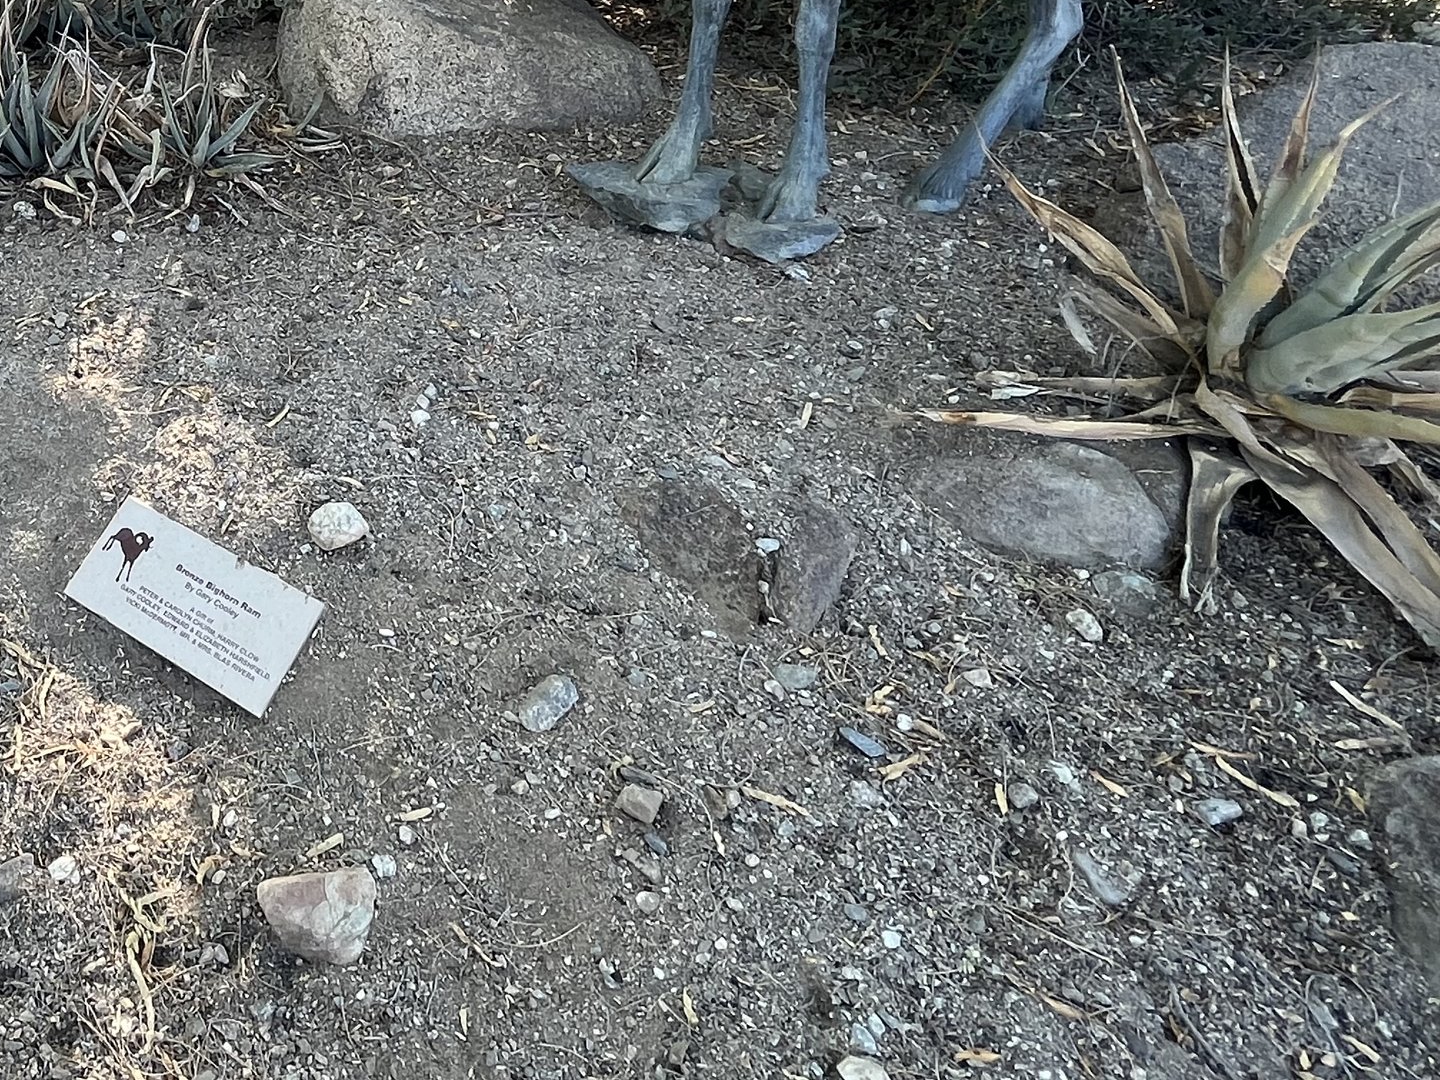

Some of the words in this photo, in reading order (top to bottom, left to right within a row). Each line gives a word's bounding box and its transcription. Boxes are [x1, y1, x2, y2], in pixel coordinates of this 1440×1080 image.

[120, 584, 137, 596] GARY
[163, 610, 189, 629] EDWARD
[195, 630, 230, 654] ELIZABETH
[139, 585, 159, 600] PETER
[164, 601, 192, 621] CAROLYN
[217, 634, 240, 650] HARRY
[175, 563, 204, 586] Bronze
[206, 580, 239, 607] Bighorn
[241, 601, 262, 619] Ram
[184, 581, 195, 593] By
[195, 588, 213, 604] Gary
[213, 599, 240, 620] Cooley
[231, 663, 256, 681] RIVERA
